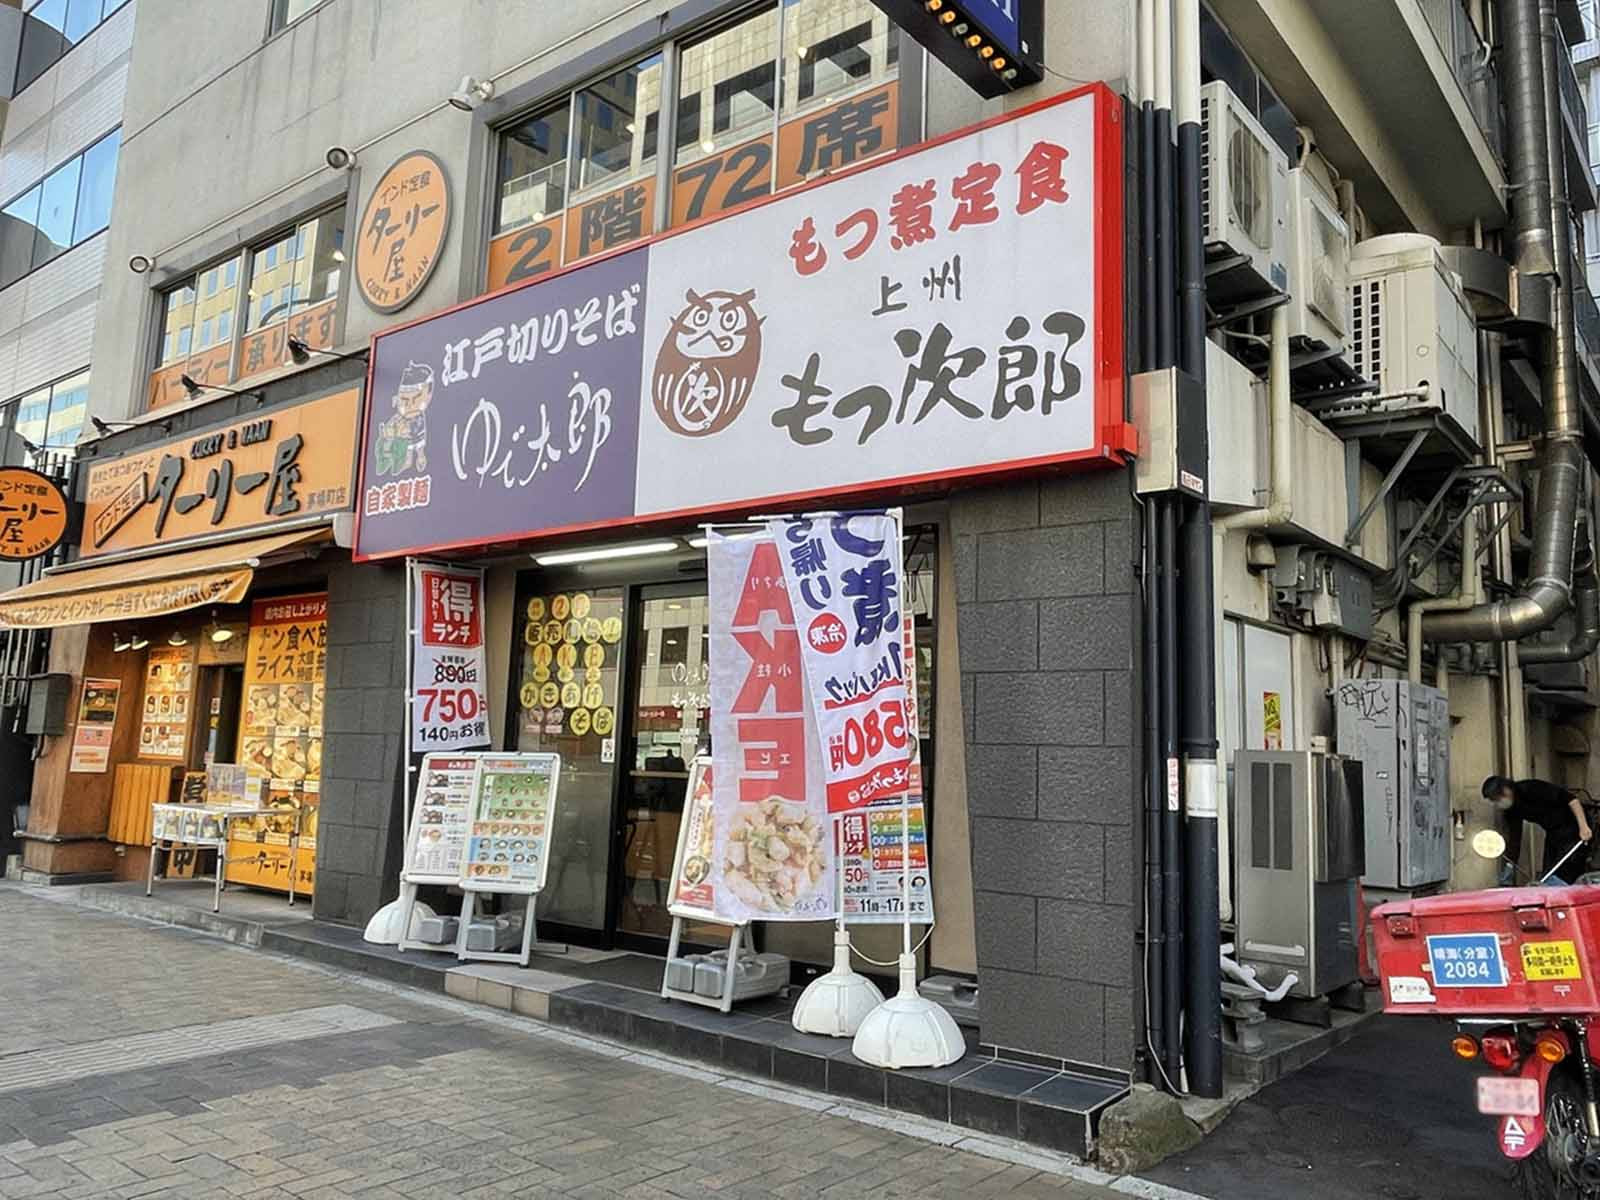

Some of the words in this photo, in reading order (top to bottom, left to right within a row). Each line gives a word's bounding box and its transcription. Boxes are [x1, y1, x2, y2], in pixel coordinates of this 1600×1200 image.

[789, 141, 1070, 276] もつ煮定食
[872, 255, 961, 316] 上州
[441, 283, 641, 387] 江戸切りそば
[771, 311, 1086, 446] もつ次郎
[451, 370, 613, 493] ゆで太郎
[0, 480, 48, 496] ンド定食
[0, 492, 59, 521] ーリー
[147, 432, 305, 539] ターリー屋
[365, 475, 432, 516] 自家製麺
[440, 579, 475, 624] 得
[432, 623, 471, 643] ランチ
[1444, 961, 1490, 979] 2084
